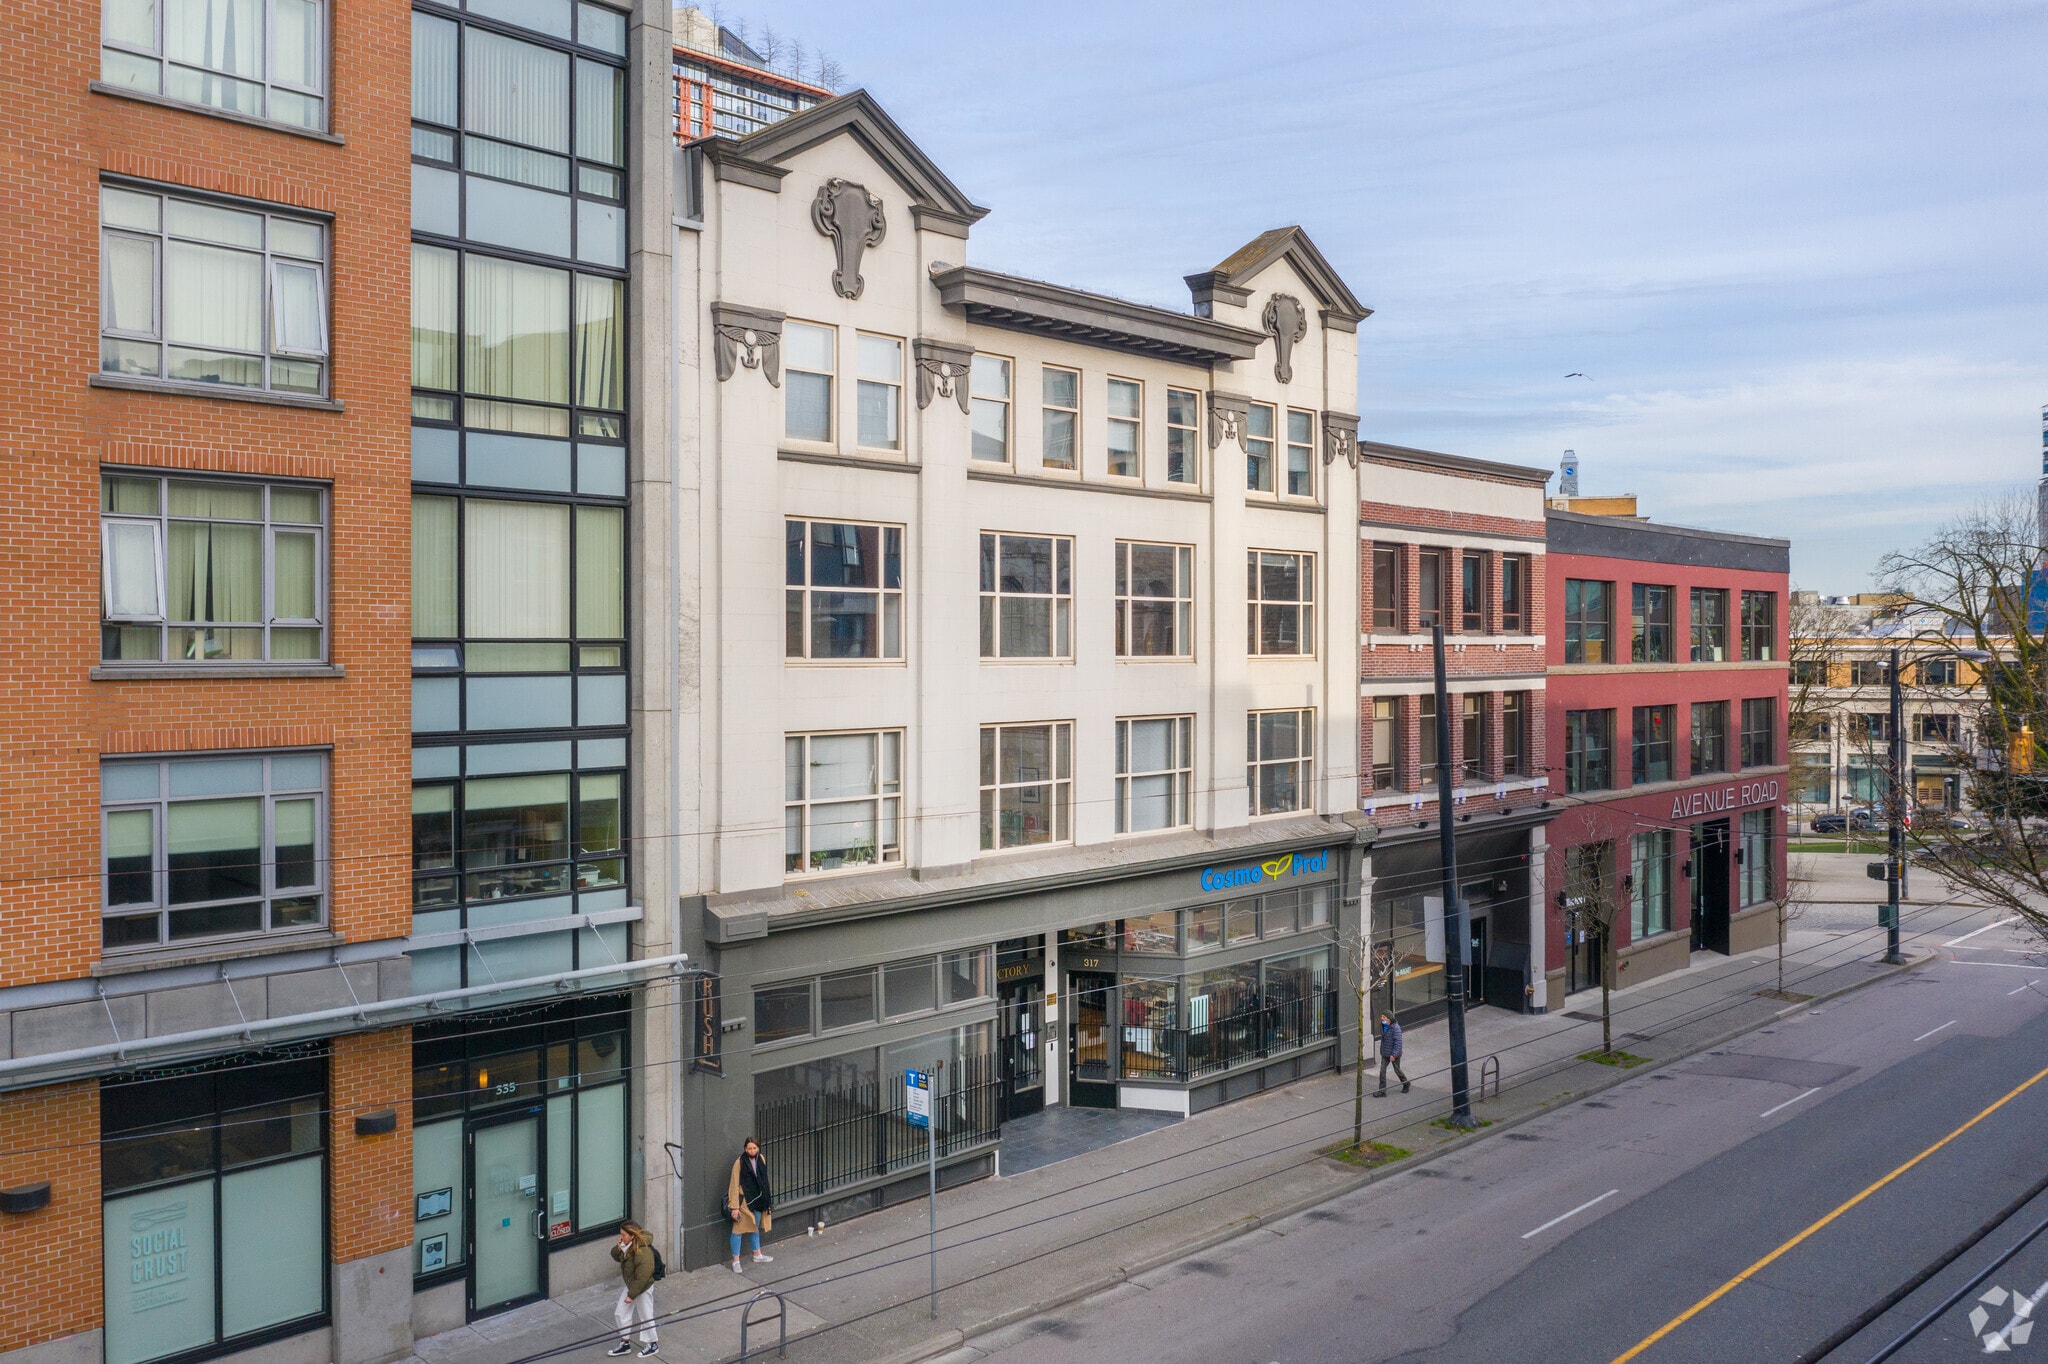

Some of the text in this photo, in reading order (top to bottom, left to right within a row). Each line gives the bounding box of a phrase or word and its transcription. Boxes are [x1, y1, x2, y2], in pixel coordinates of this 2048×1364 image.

[1671, 781, 1779, 818] AVENUE ROAD
[1201, 849, 1328, 891] Cosmo Prof
[996, 964, 1029, 979] CTORY
[1083, 958, 1099, 967] 317
[703, 977, 714, 1055] RUSH
[132, 1226, 186, 1258] SOCIAL
[132, 1250, 187, 1283] CRUST
